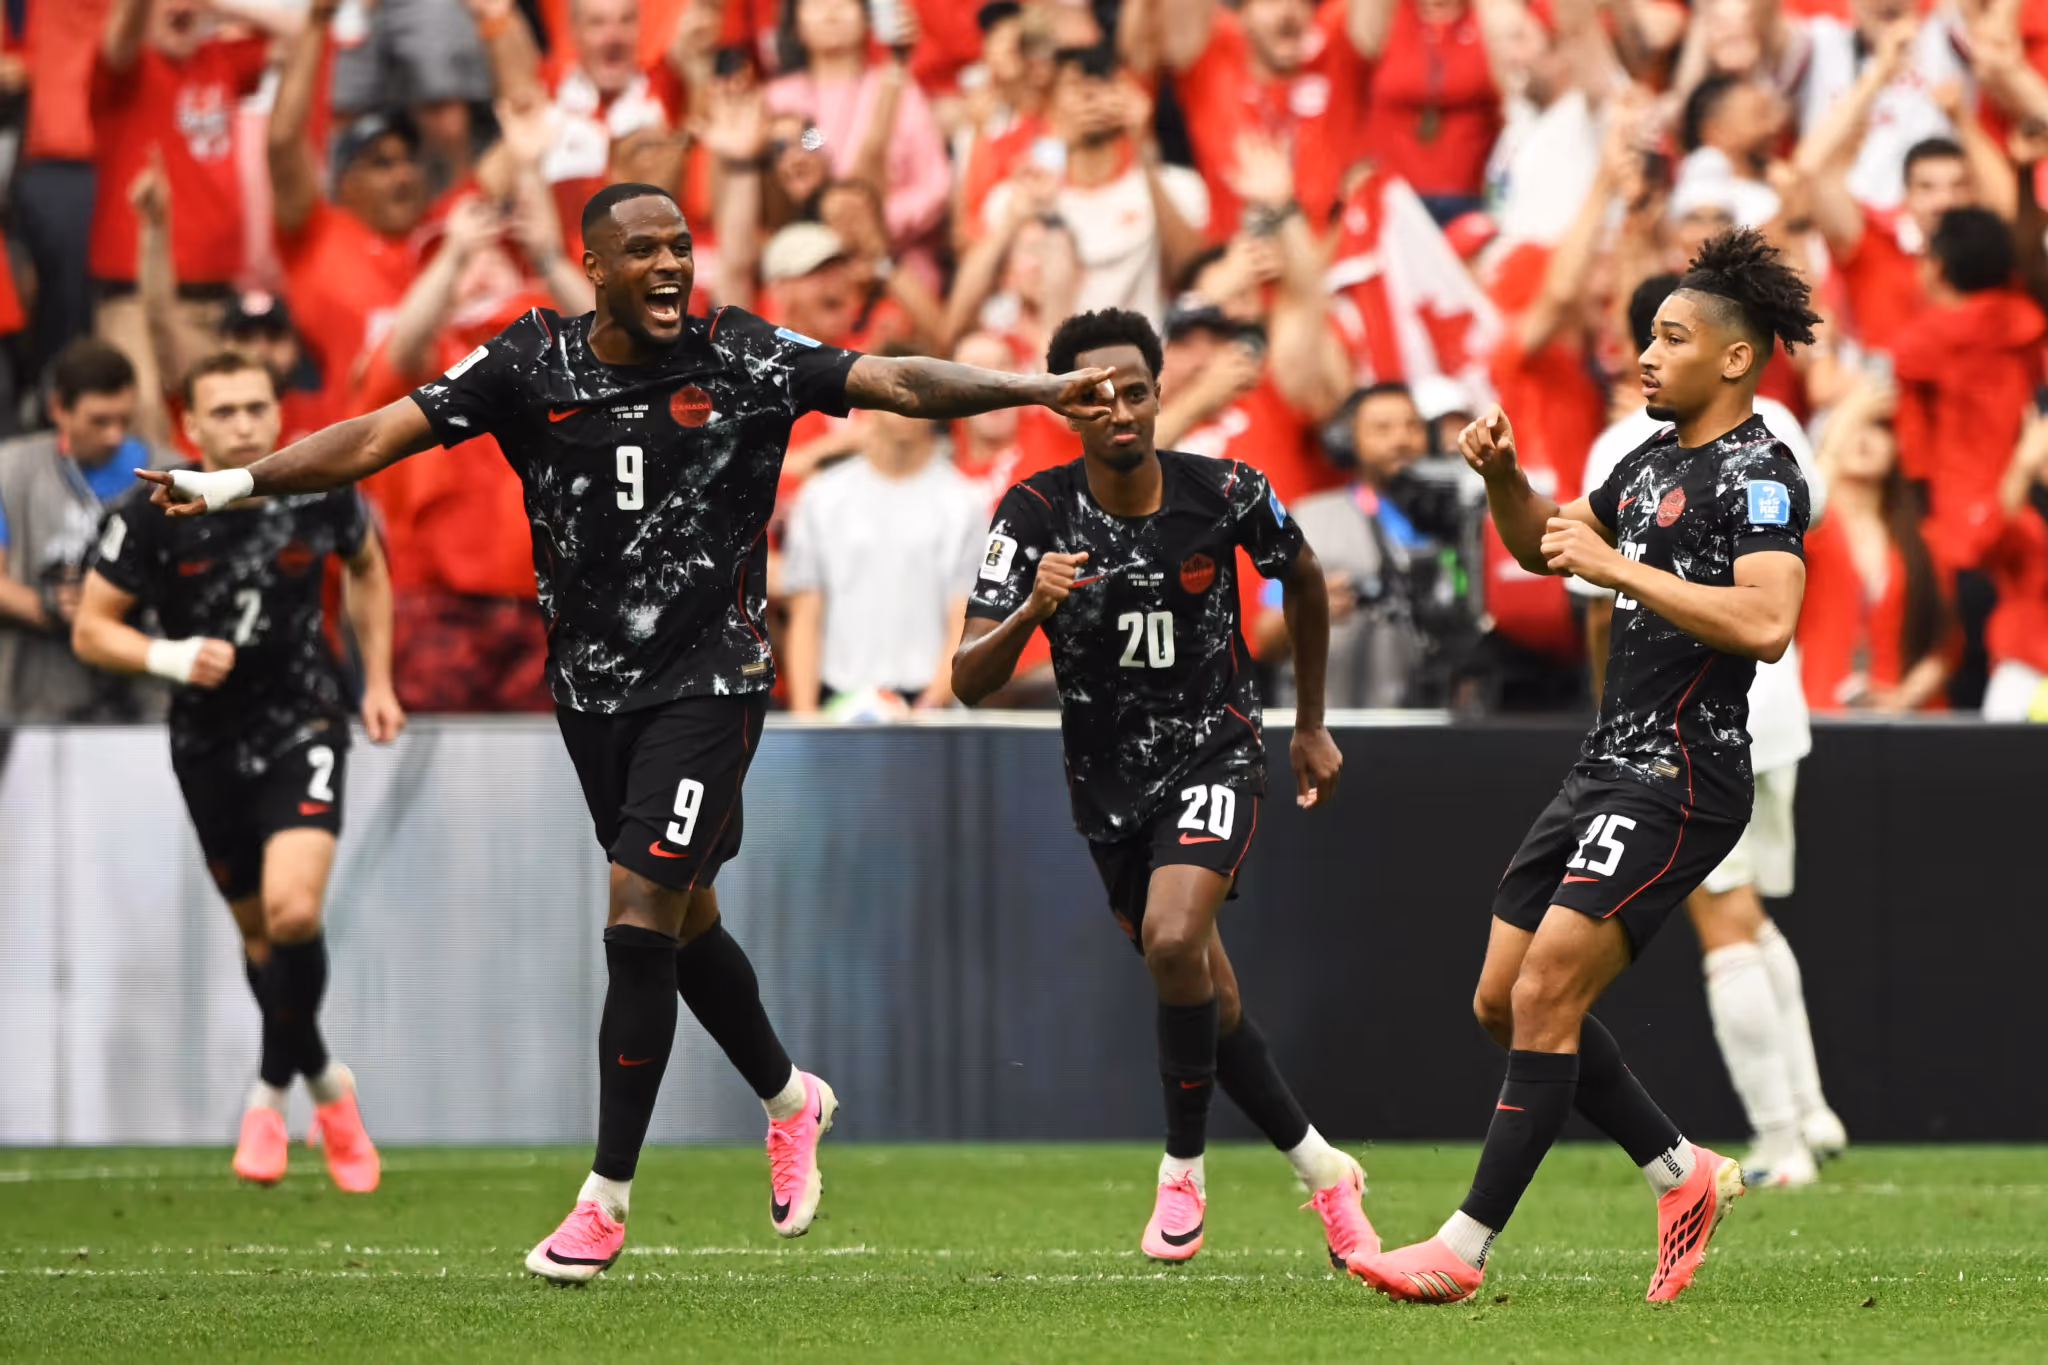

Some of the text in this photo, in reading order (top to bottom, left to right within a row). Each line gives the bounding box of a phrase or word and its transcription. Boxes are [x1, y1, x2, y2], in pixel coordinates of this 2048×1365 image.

[616, 446, 644, 510] 9
[1118, 611, 1175, 668] 20
[307, 745, 334, 801] 2
[666, 778, 704, 846] 9
[1177, 784, 1235, 840] 20
[1566, 814, 1637, 876] 25
